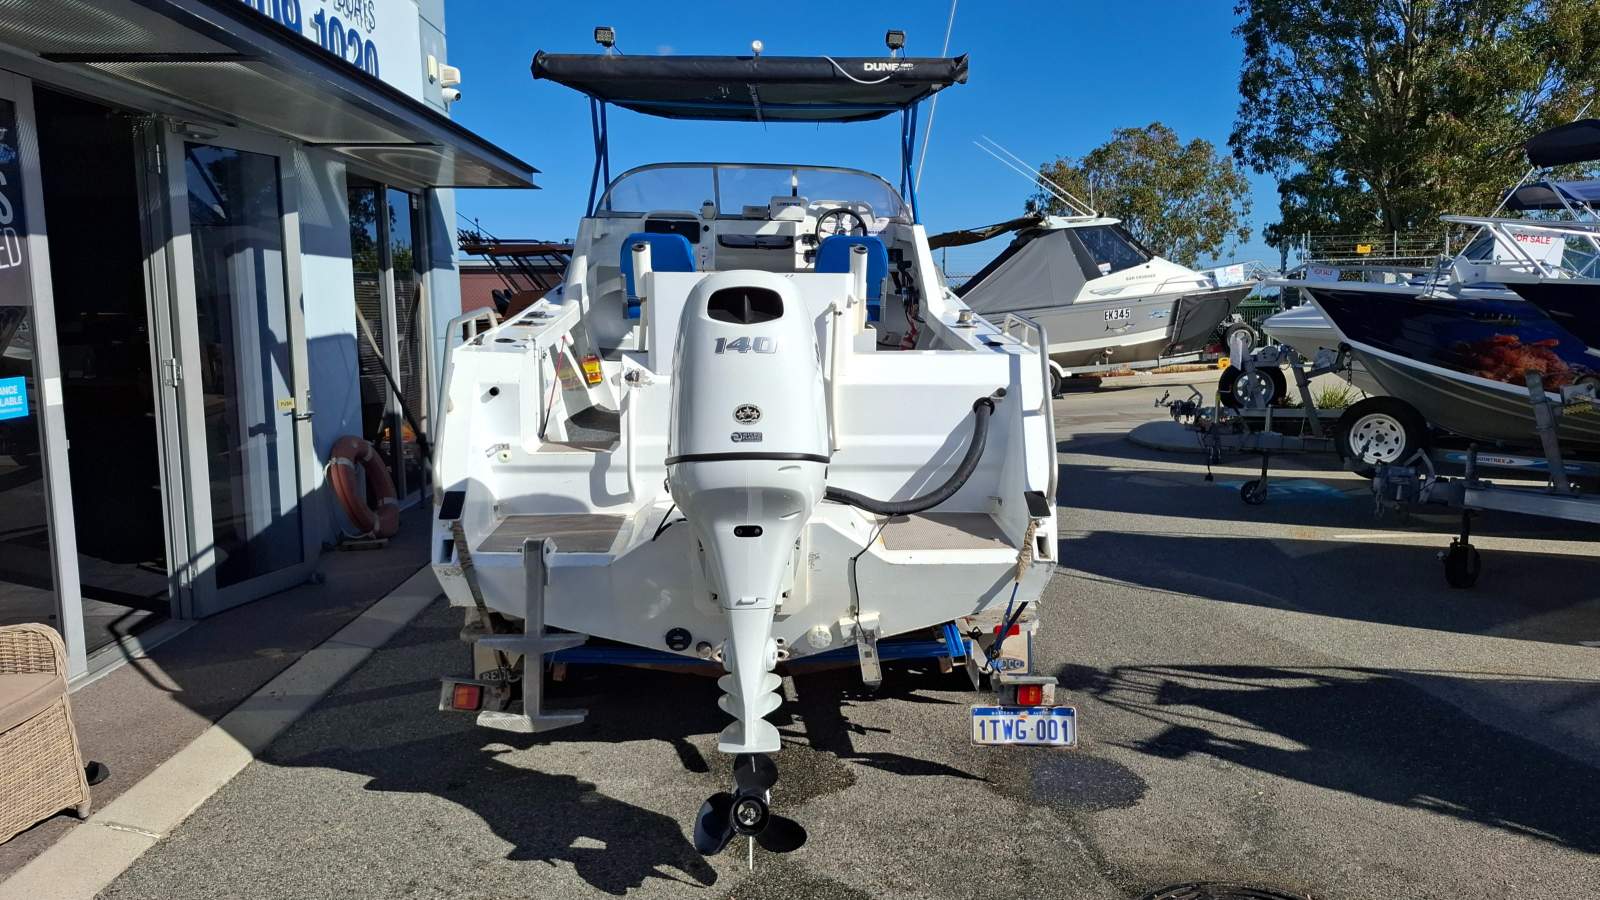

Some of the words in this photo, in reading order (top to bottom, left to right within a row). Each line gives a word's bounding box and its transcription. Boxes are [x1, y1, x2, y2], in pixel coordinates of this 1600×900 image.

[1530, 234, 1552, 244] SALE
[1104, 310, 1130, 321] EK345
[715, 336, 778, 354] 140
